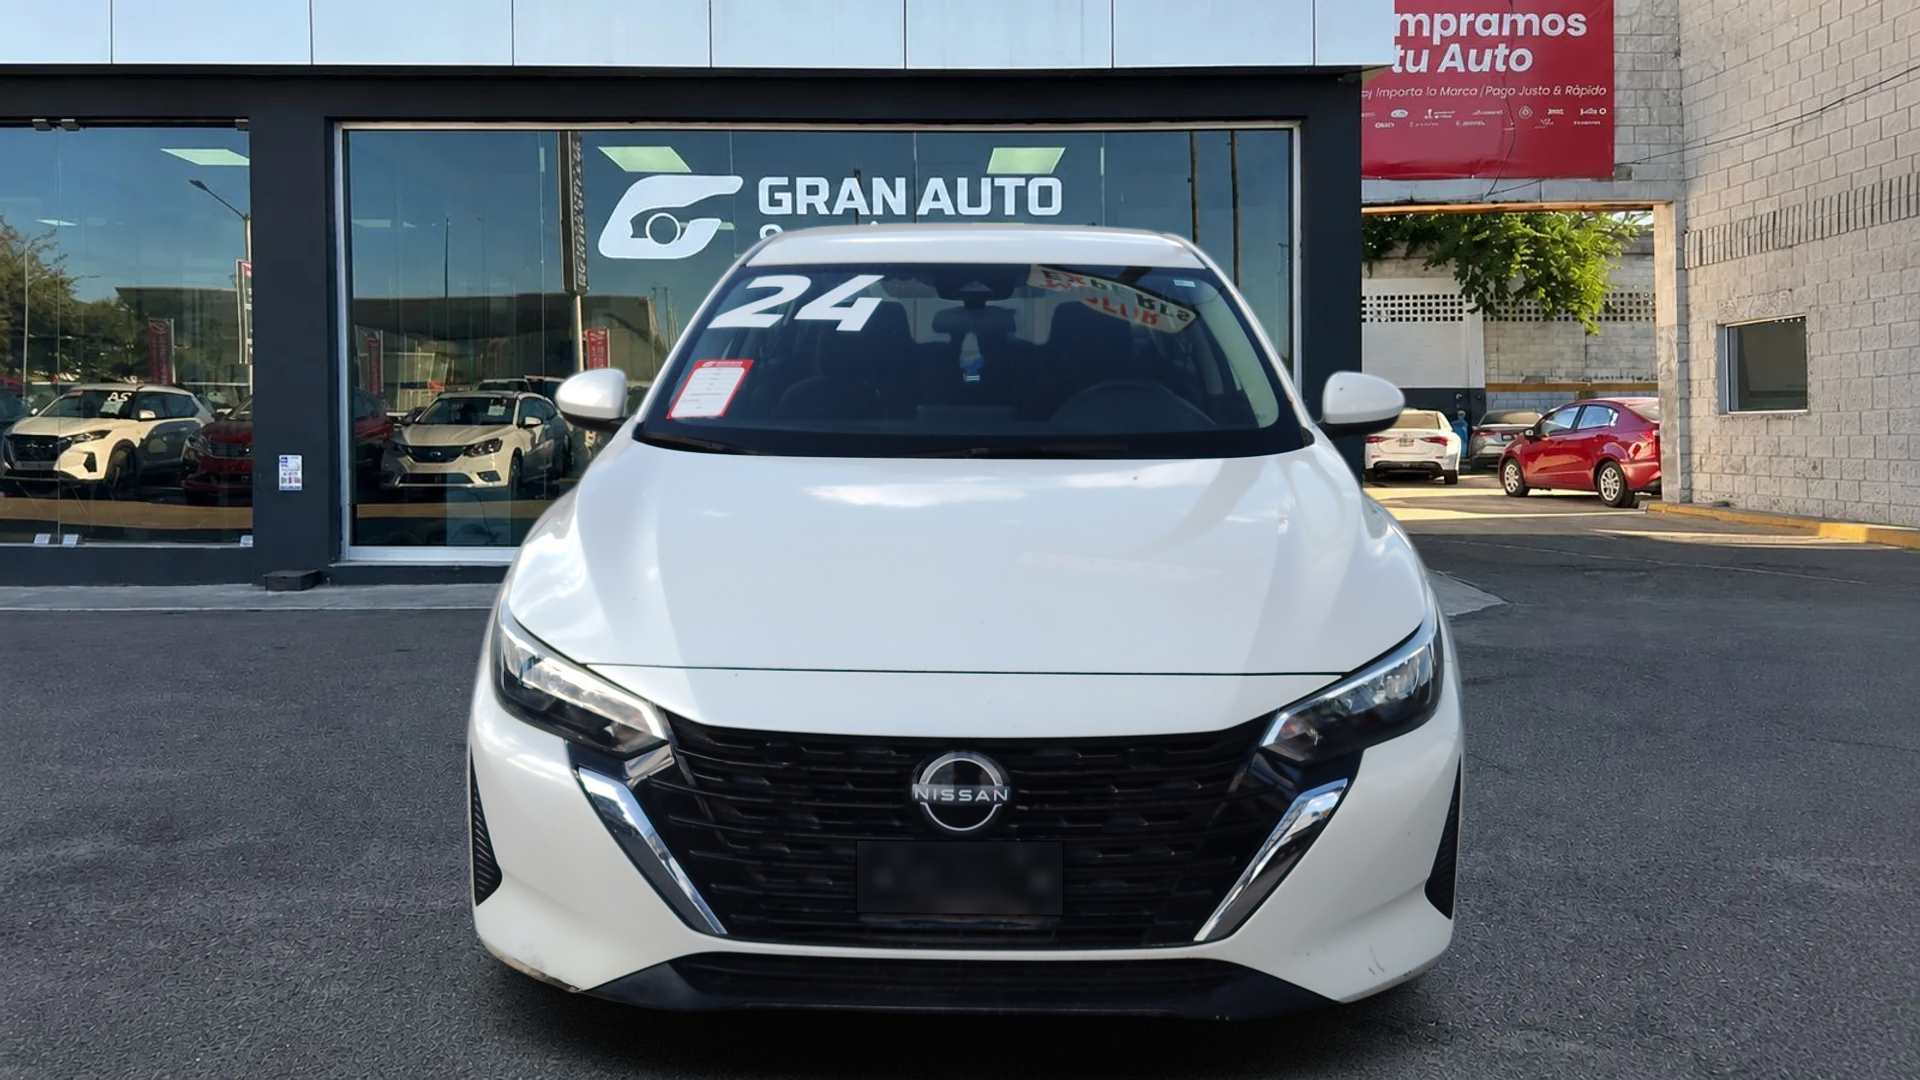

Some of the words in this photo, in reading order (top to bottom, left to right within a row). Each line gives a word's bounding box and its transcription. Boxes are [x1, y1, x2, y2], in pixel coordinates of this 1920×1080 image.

[1392, 44, 1430, 73] tu
[1437, 43, 1533, 73] Auto
[1376, 87, 1423, 99] Importa
[1426, 86, 1437, 97] la
[1440, 86, 1478, 97] Marca
[1518, 86, 1551, 96] Justo
[1553, 85, 1561, 95] &
[1565, 84, 1607, 98] Rápido
[758, 177, 906, 215] GRAN
[916, 177, 1062, 216] AUTO
[707, 275, 885, 331] 24
[914, 787, 1008, 801] NISSAN
